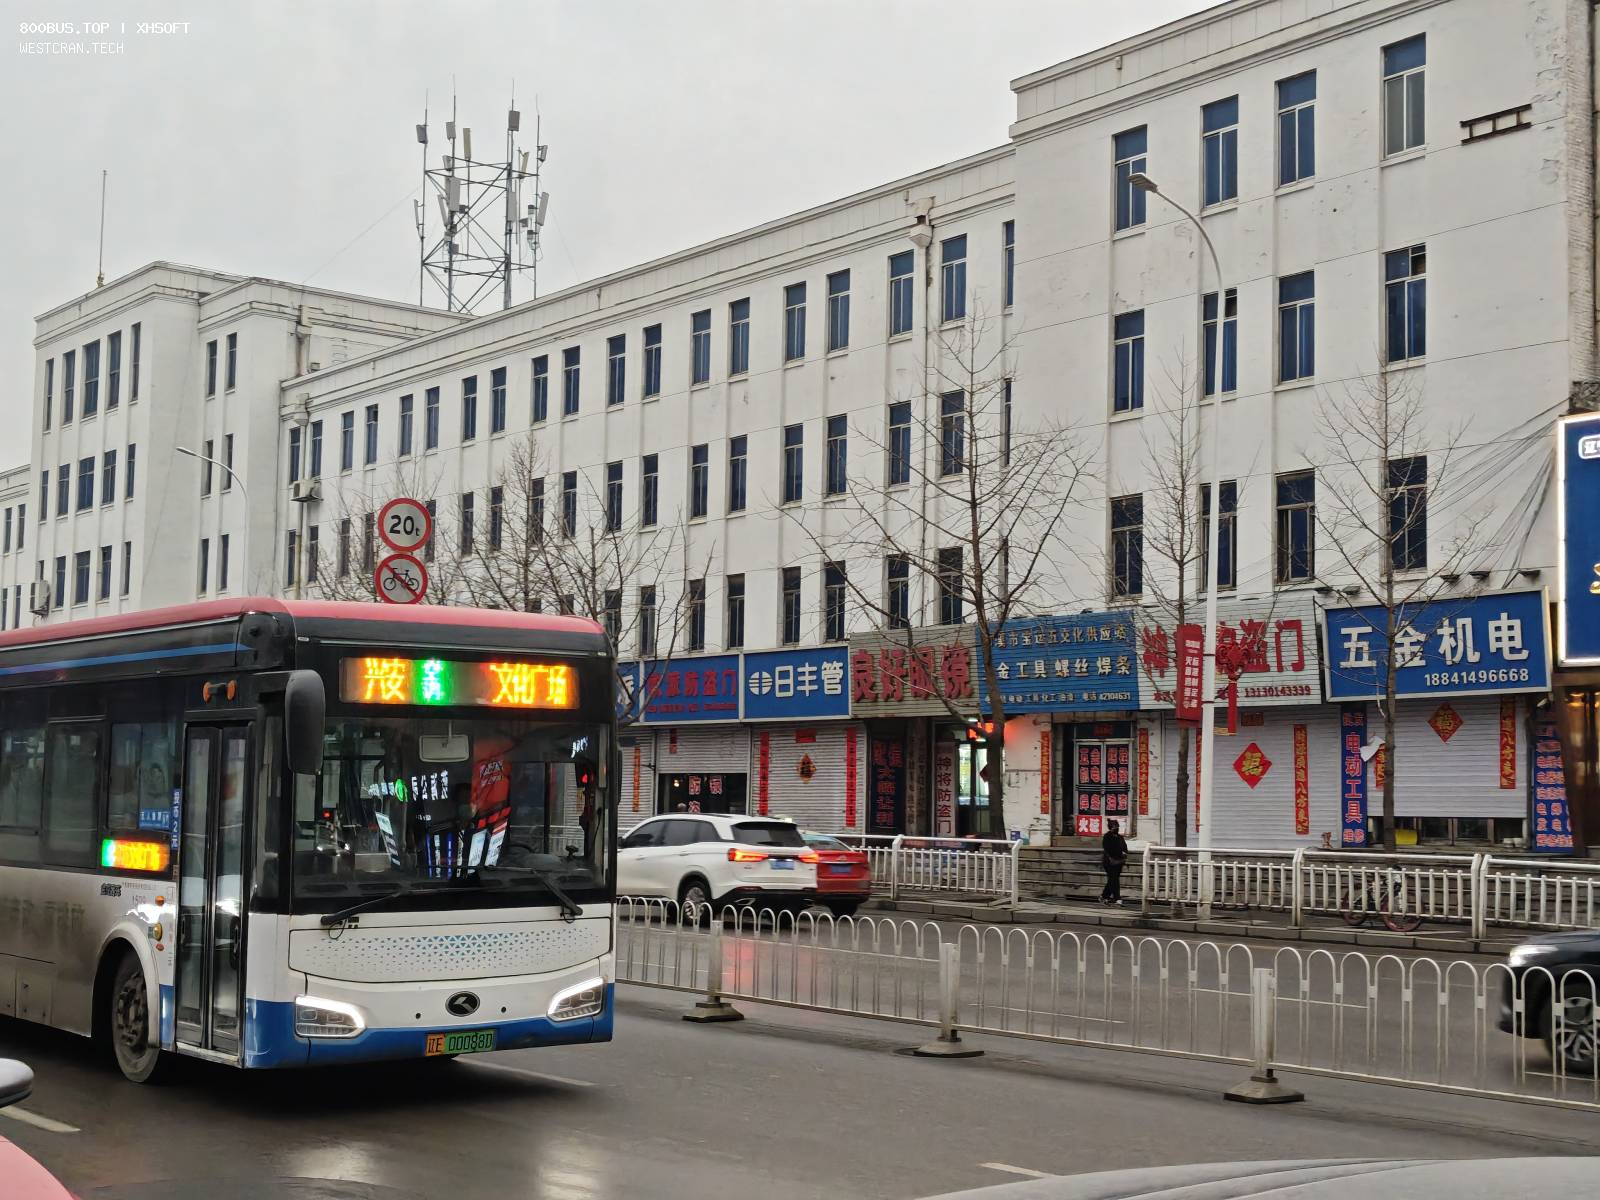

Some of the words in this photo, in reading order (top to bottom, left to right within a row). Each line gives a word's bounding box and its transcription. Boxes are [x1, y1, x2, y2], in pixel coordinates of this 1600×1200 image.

[389, 514, 420, 537] 20t
[1339, 612, 1530, 670] 五金机电
[363, 657, 406, 701] 兴安
[489, 662, 567, 705] 文化广场
[775, 660, 844, 698] 日丰管
[851, 644, 974, 702] 良好眼镜
[1244, 684, 1312, 698] 13130143339
[1424, 668, 1530, 687] 18841496668
[1344, 731, 1363, 824] 电动工具
